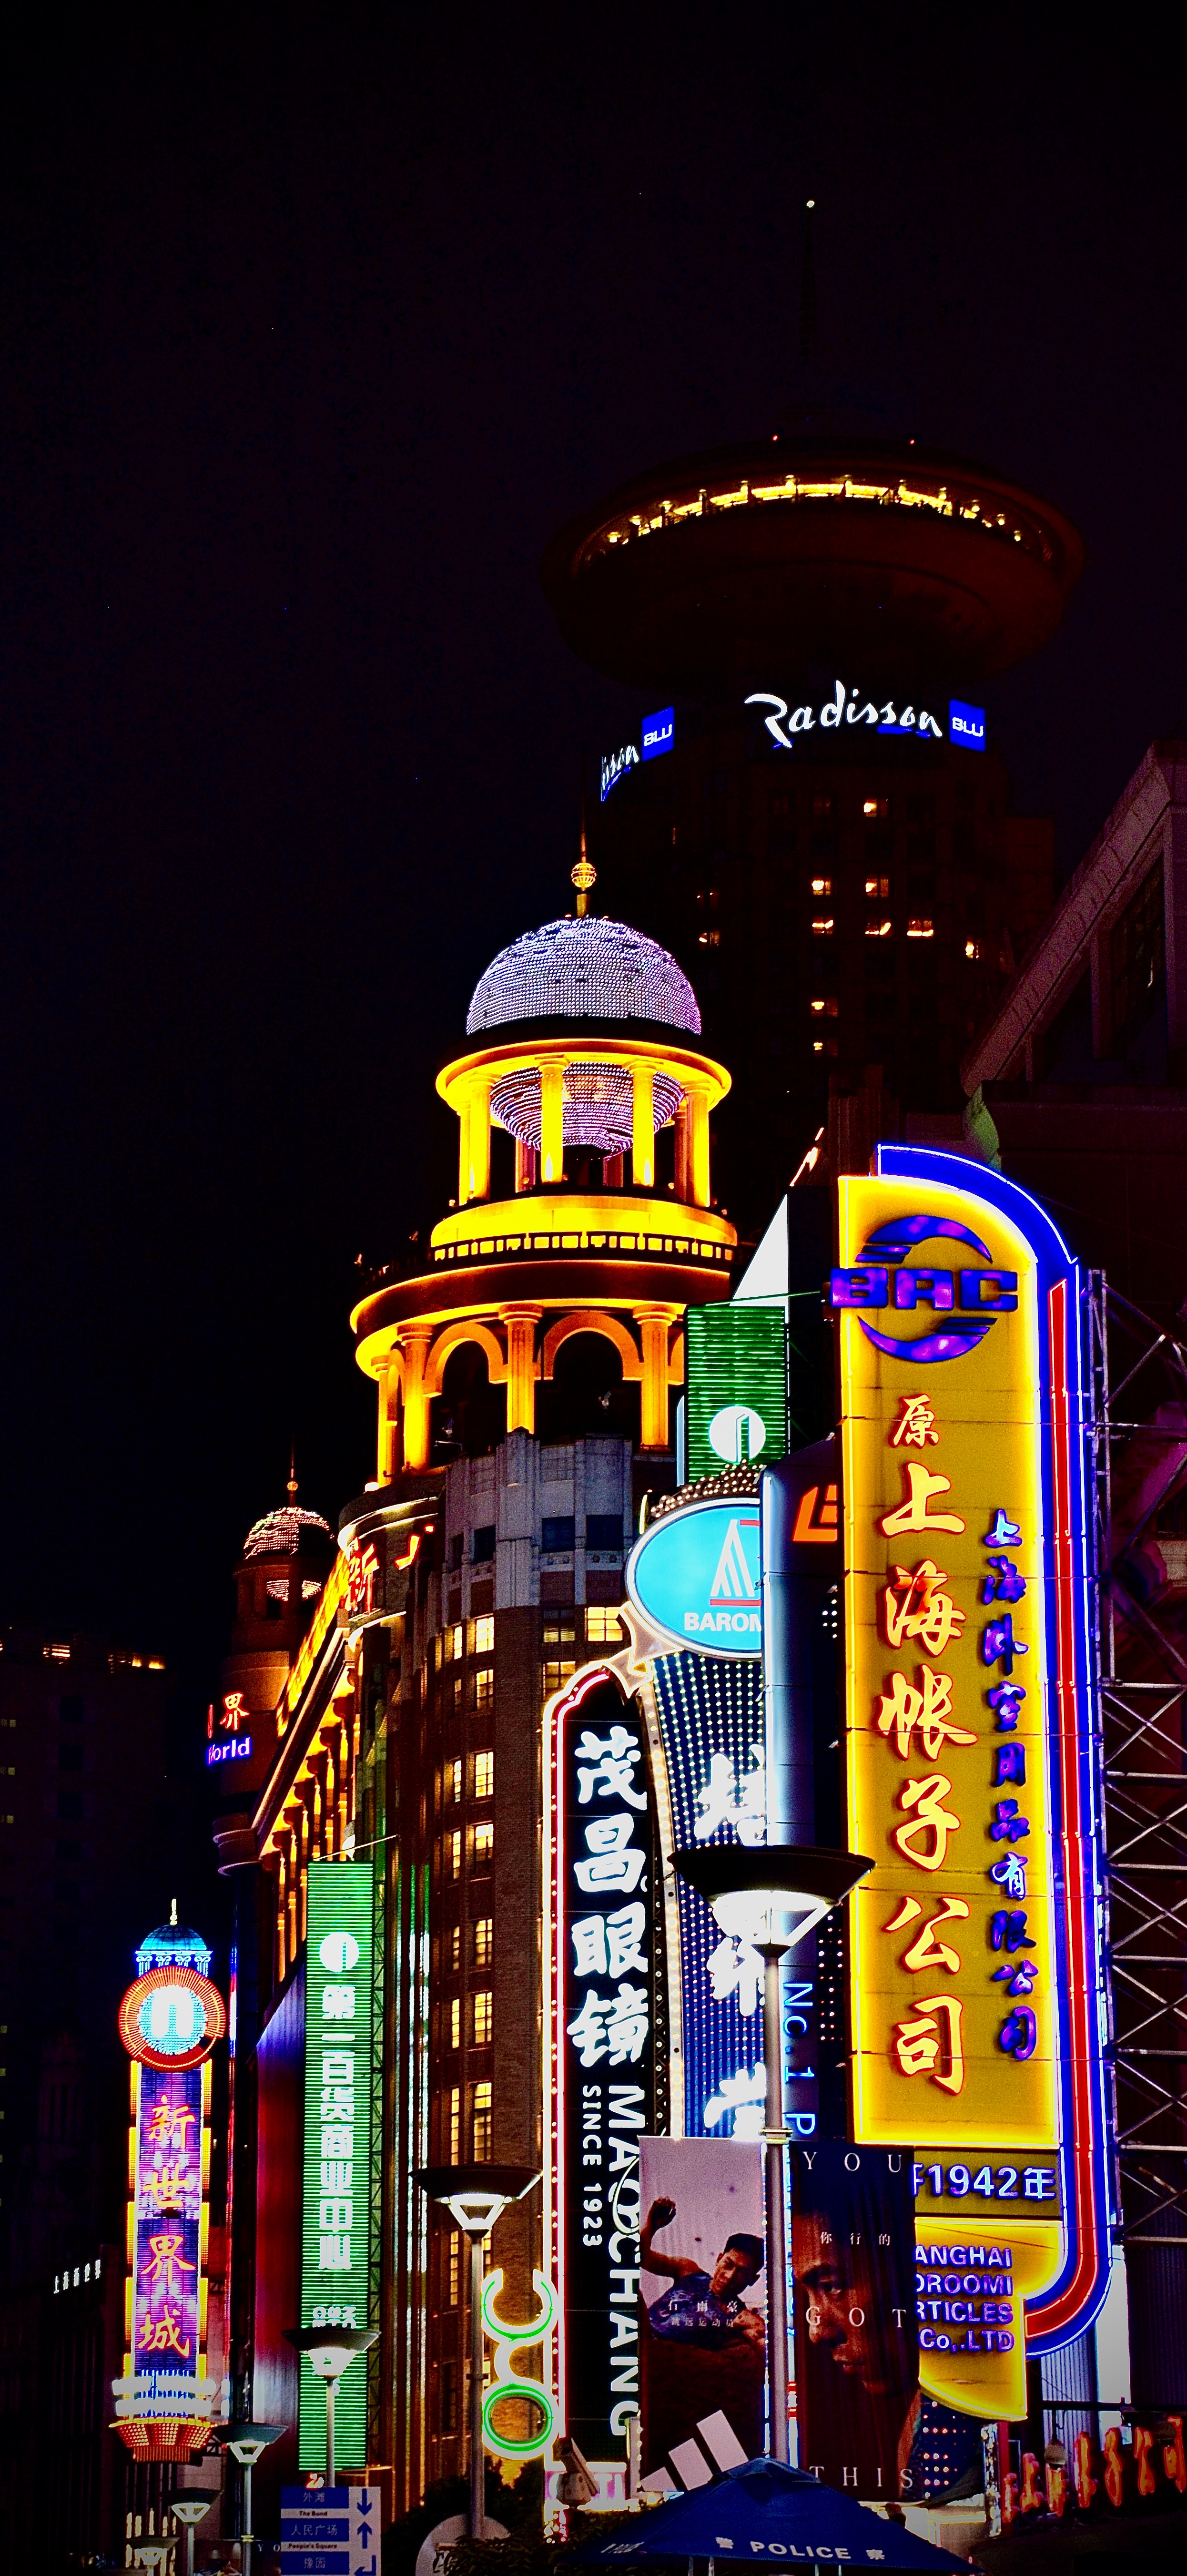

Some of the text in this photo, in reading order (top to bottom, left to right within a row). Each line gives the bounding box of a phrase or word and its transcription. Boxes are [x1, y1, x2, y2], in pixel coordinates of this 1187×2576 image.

[744, 680, 985, 748] Radisson BLU
[644, 724, 672, 747] BLU
[831, 1267, 1018, 1312] BAC
[567, 1726, 649, 2067] 茂昌眼镜
[318, 1985, 356, 2271] 第一百货商业中心
[582, 2085, 602, 2246] SINCE 1923
[802, 2151, 902, 2173] YOU
[138, 2094, 195, 2358] 新世界城
[820, 2231, 890, 2246] 你行的
[805, 2306, 906, 2328] GOT
[809, 2466, 913, 2488] THIS
[303, 2492, 325, 2503] 外滩
[291, 2524, 338, 2536] 人民广场
[750, 2541, 852, 2559] POLICE
